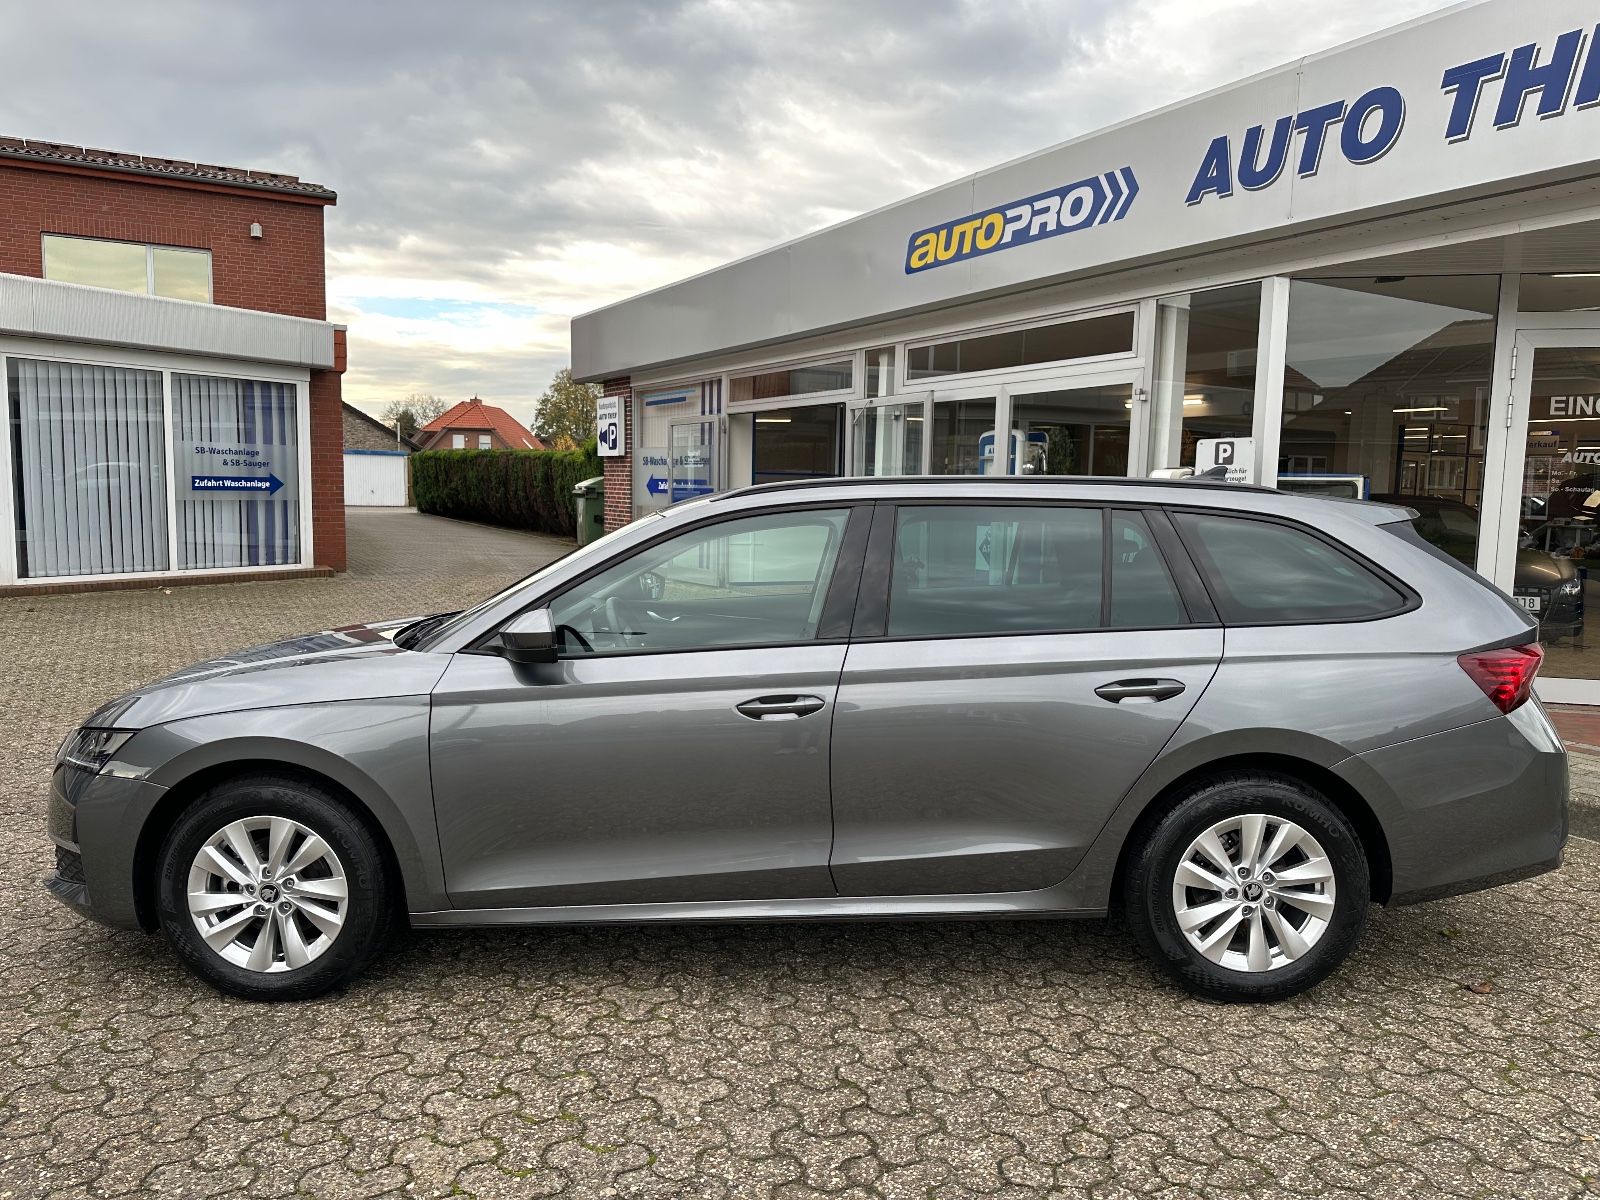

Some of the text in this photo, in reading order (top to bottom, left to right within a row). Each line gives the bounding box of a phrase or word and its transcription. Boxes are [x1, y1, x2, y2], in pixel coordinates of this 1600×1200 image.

[1185, 86, 1406, 207] AUTO
[1549, 396, 1600, 415] EIN
[195, 446, 260, 457] SB-Waschanlage
[230, 459, 270, 469] SB-Sauger
[642, 456, 679, 468] SB-Waschage
[194, 479, 270, 488] Zufahrt Waschanlage
